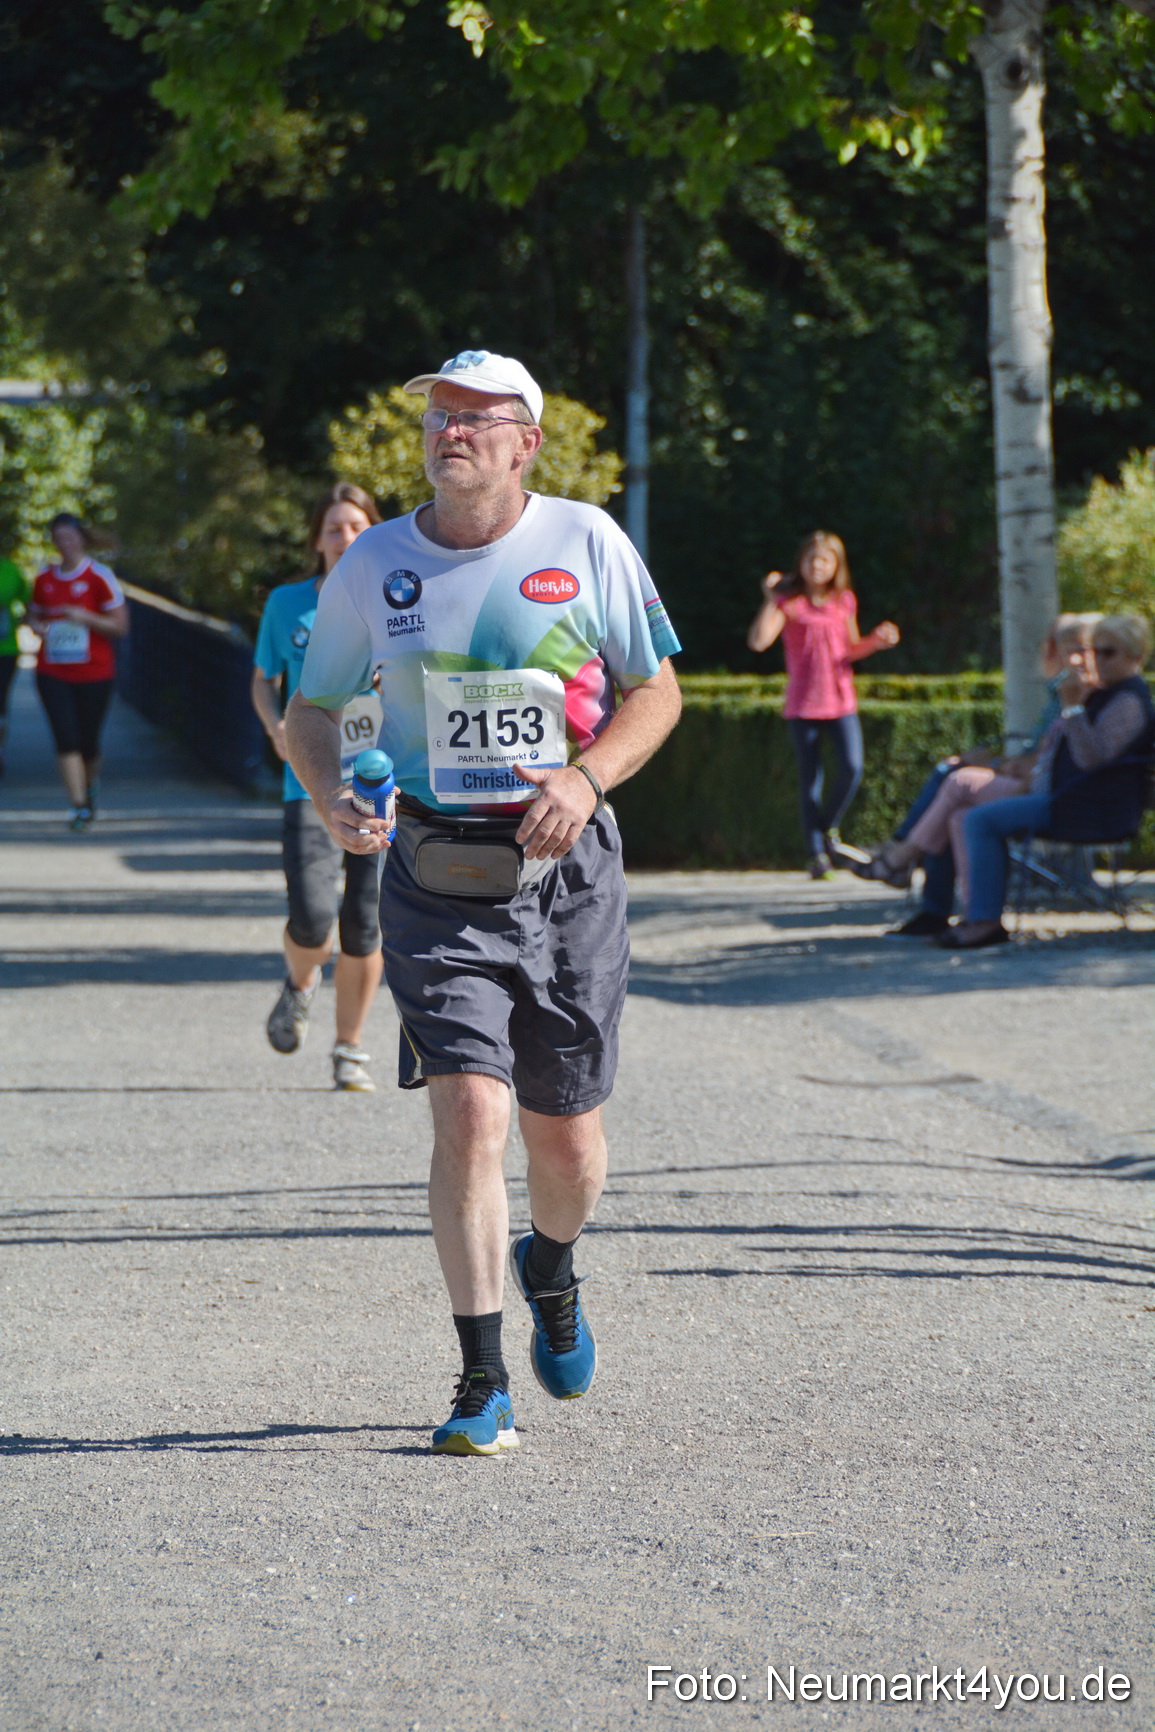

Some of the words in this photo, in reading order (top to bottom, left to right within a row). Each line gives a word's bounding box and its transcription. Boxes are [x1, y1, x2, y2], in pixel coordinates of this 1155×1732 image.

[384, 570, 419, 585] BMW
[528, 578, 574, 595] Hervis
[386, 614, 426, 630] PARTL
[388, 624, 426, 639] Neumarkt
[463, 682, 525, 698] BOCK
[447, 706, 545, 749] 2153
[457, 755, 486, 763] PARTL
[487, 753, 527, 763] Neumarkt
